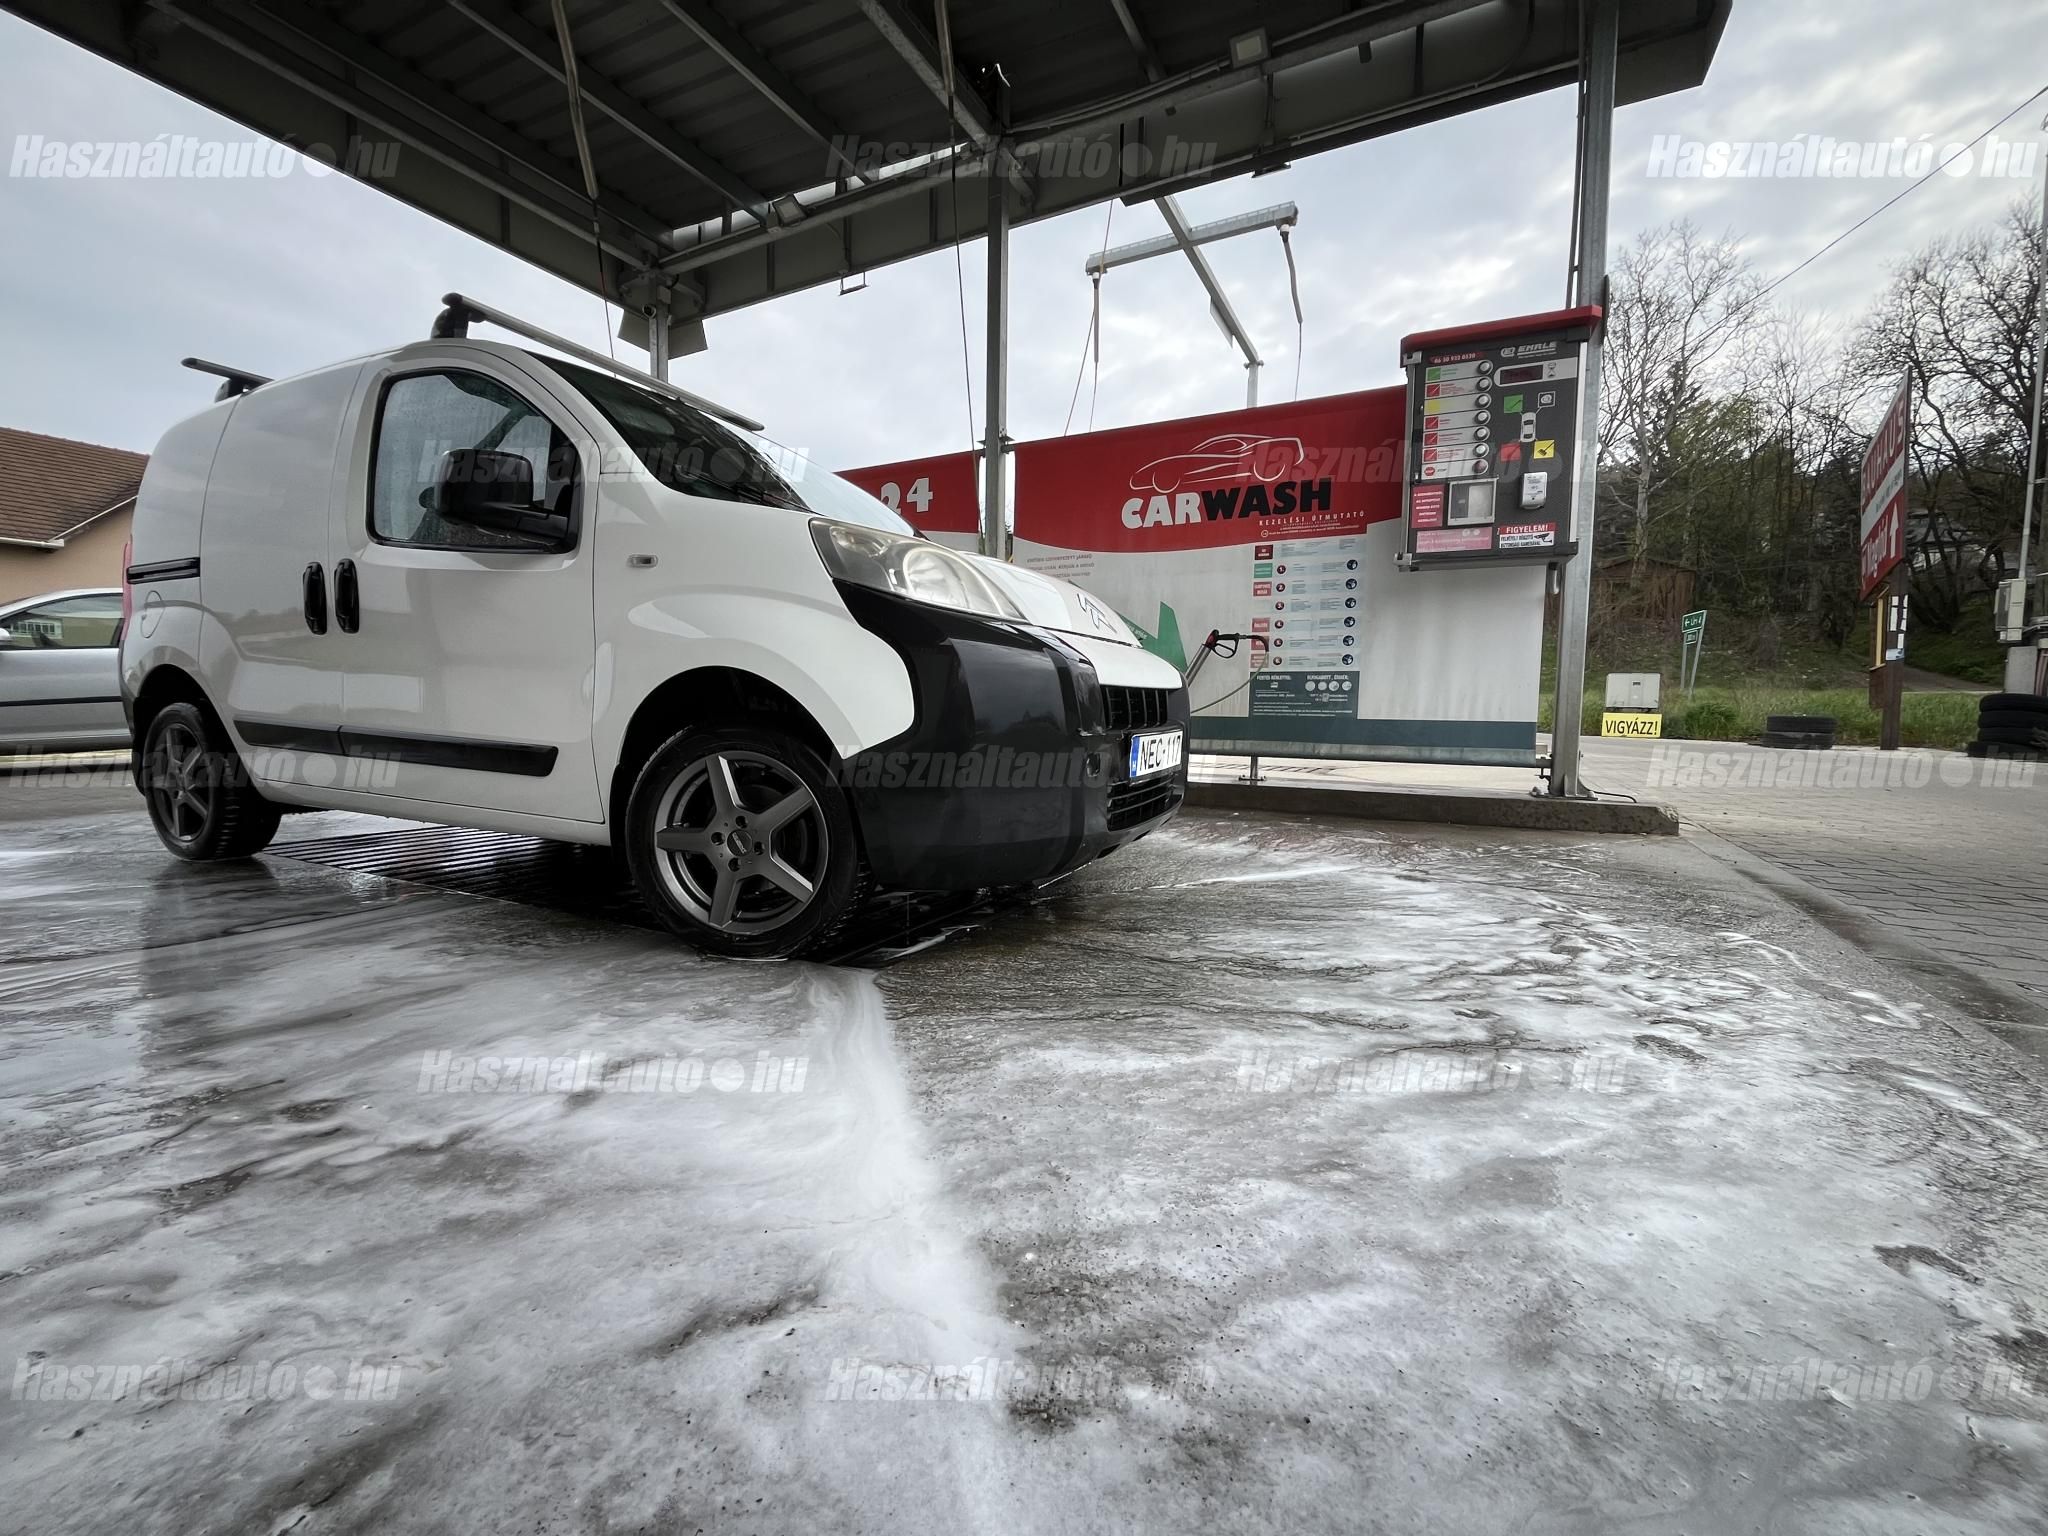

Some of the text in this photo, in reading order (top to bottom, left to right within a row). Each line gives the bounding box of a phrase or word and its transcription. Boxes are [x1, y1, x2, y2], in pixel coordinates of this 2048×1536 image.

[1121, 477, 1332, 529] CARWASH
[1506, 524, 1548, 533] FIGYELEM!
[1605, 717, 1658, 735] VIGYÁZZ!
[1140, 735, 1181, 771] NEC-117
